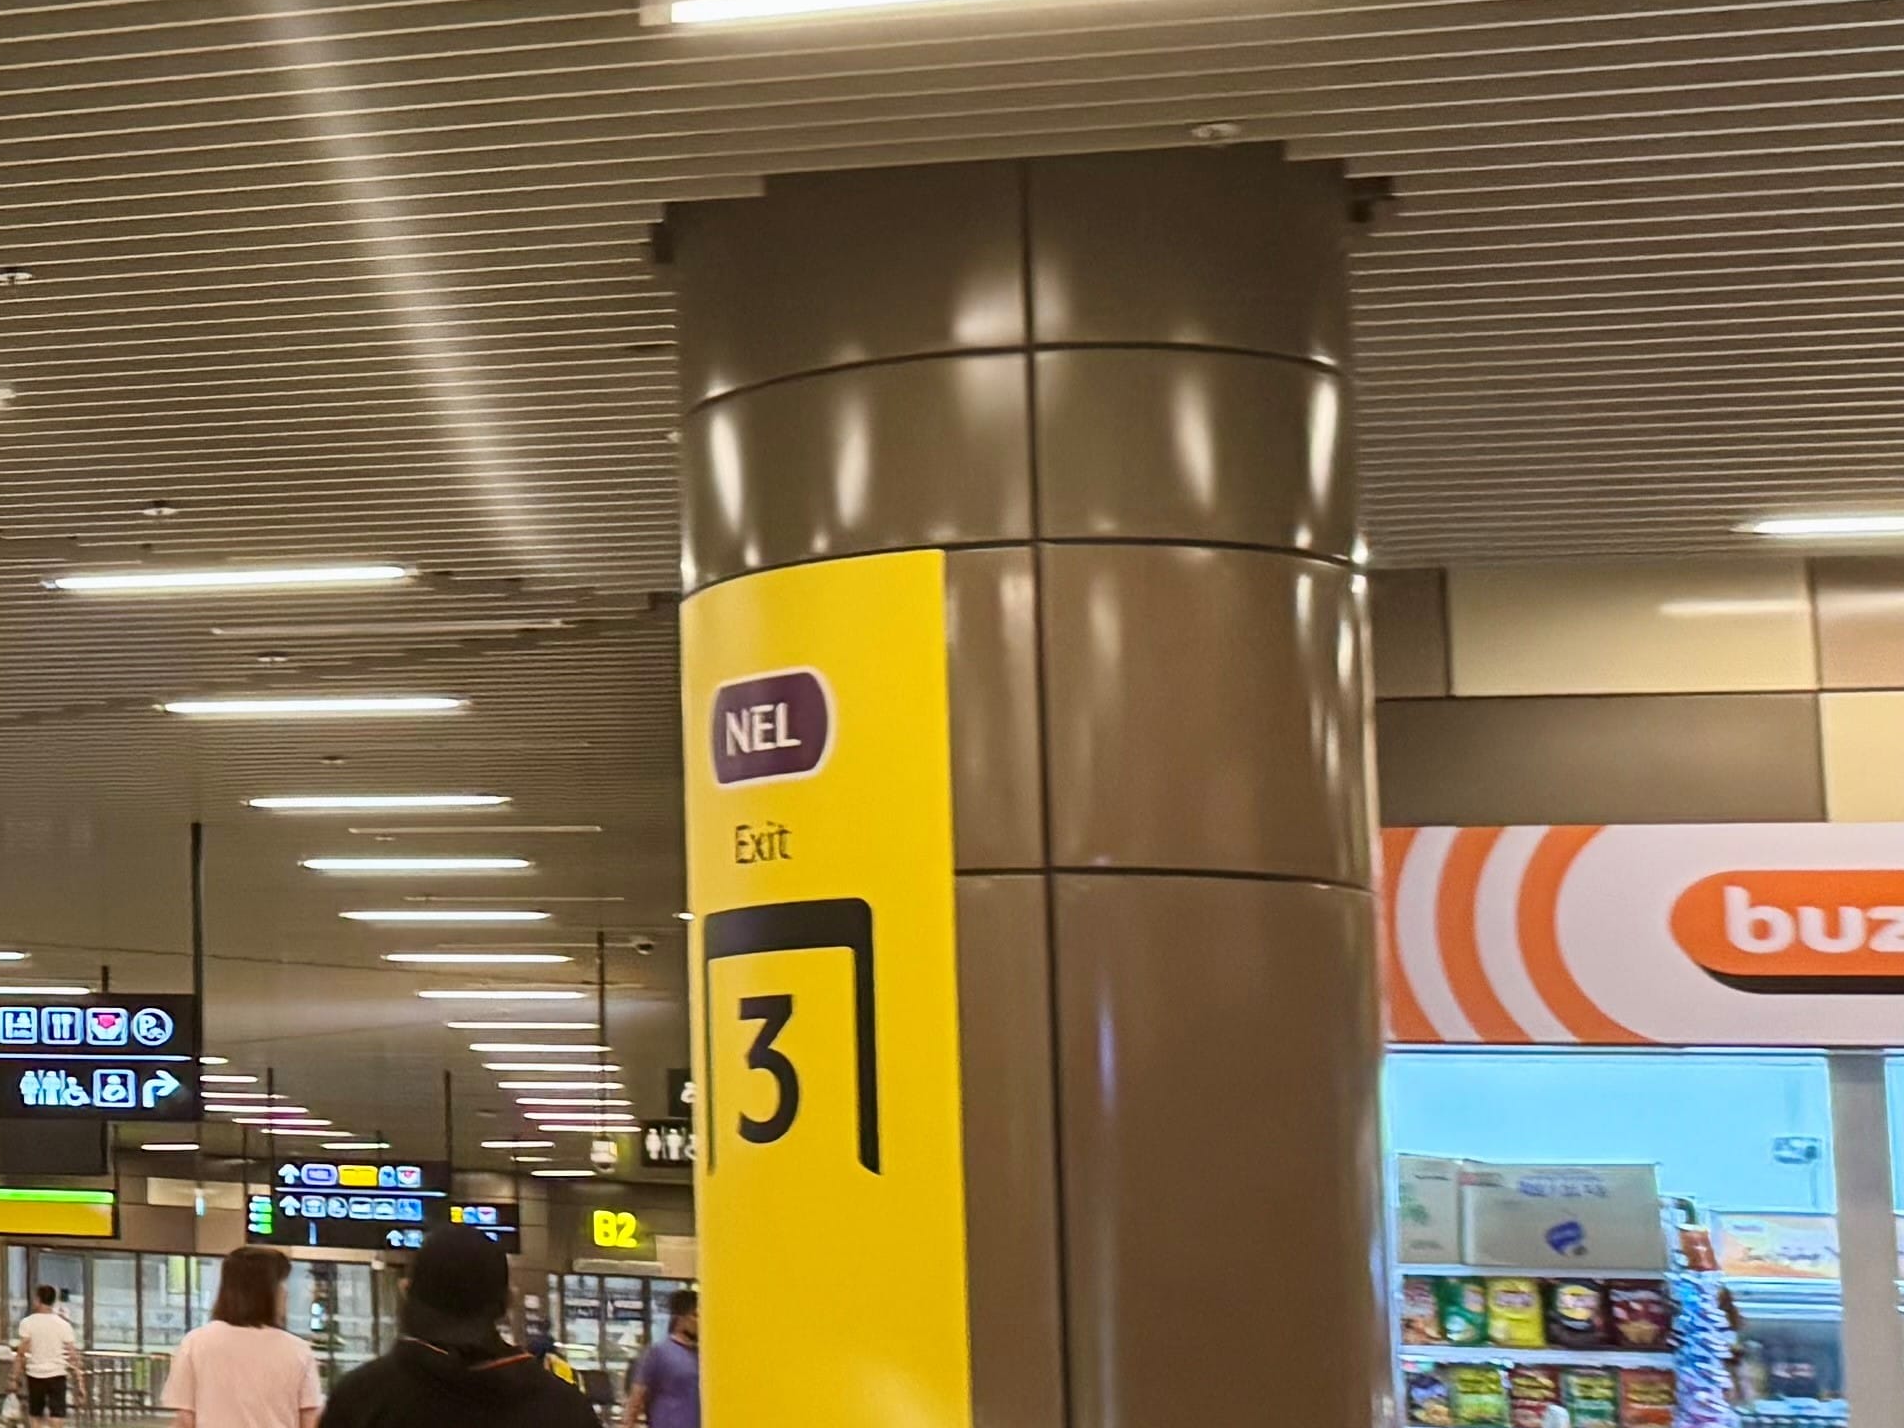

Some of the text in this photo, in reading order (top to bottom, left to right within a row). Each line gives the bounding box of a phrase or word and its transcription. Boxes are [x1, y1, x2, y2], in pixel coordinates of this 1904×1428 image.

[724, 701, 802, 757] NEL
[733, 821, 792, 865] Exit
[736, 993, 800, 1144] 3
[592, 1209, 638, 1249] B2
